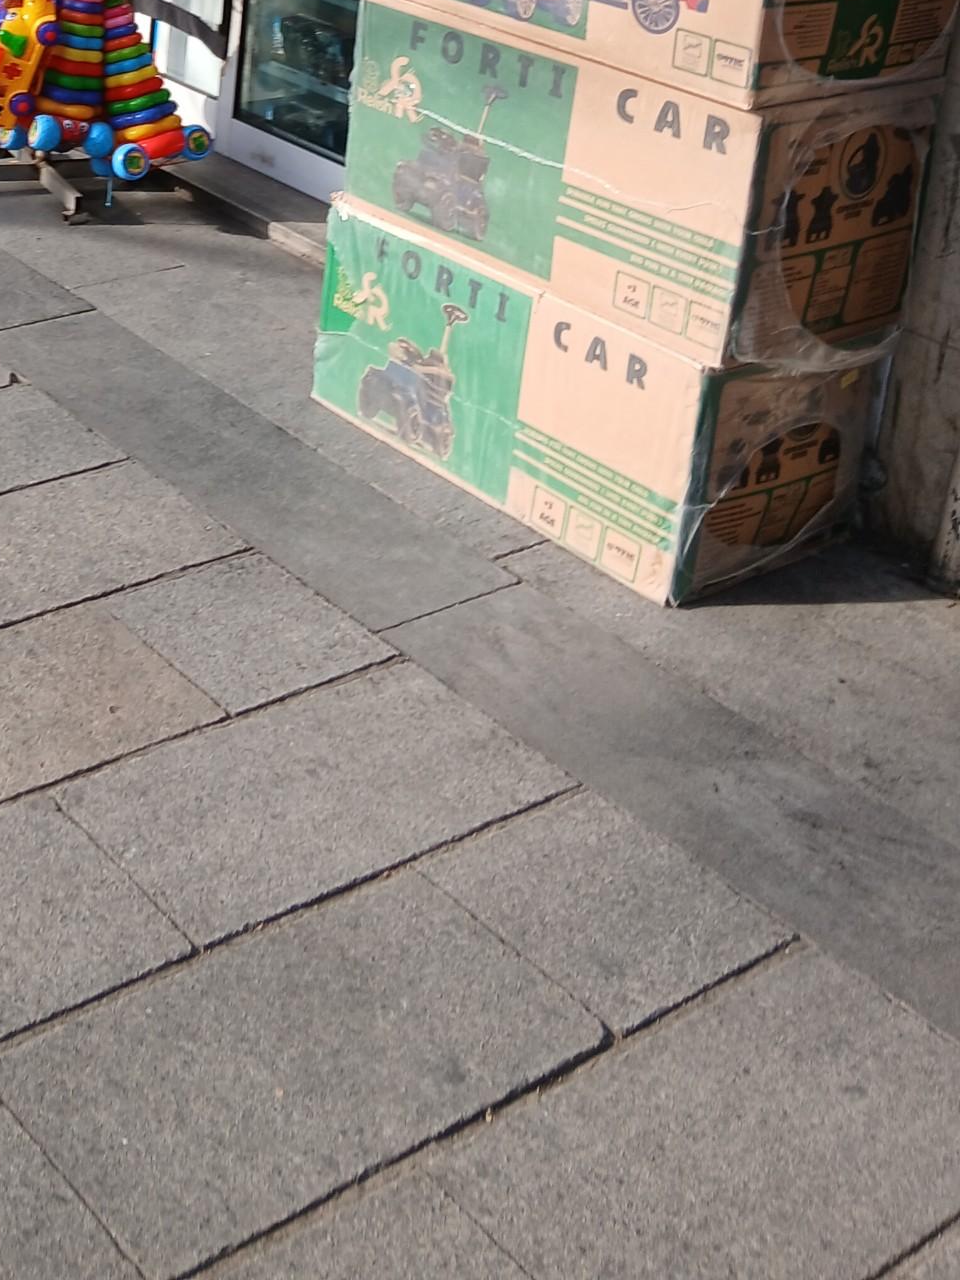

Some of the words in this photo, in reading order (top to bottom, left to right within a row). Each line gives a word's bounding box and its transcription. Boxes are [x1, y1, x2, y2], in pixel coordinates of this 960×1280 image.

[408, 19, 567, 99] FORTI
[616, 88, 732, 155] CAR
[375, 235, 511, 323] FORTI
[553, 321, 649, 390] CAR
